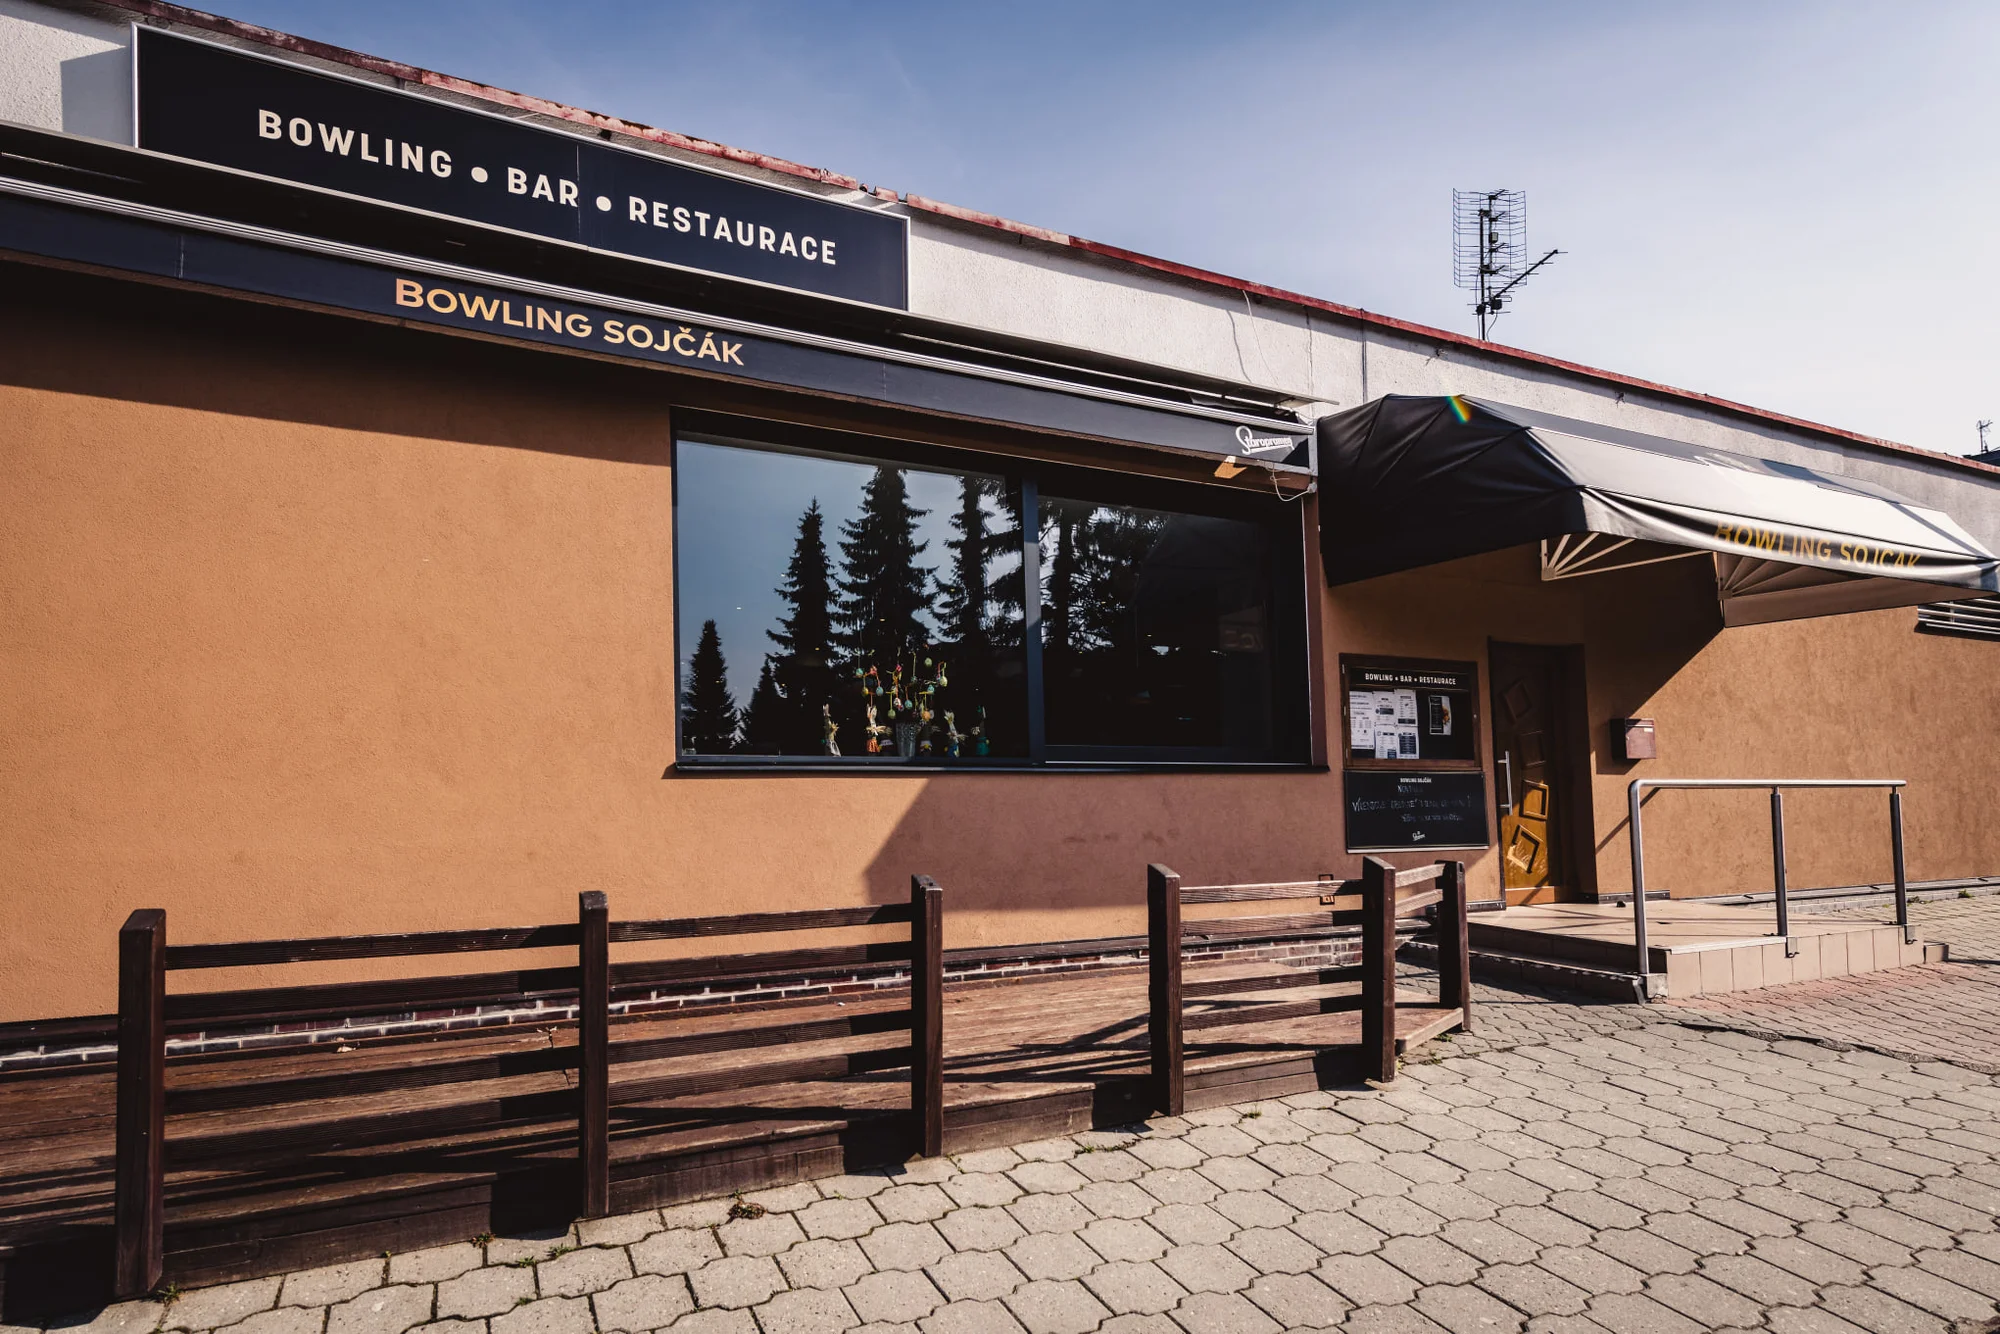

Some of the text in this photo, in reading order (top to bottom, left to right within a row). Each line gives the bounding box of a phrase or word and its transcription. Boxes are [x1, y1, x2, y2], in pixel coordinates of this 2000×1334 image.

[258, 108, 837, 266] BOWLING BAR RESTAURACE
[394, 278, 744, 366] BOWLING SOJČÁK
[1714, 521, 1831, 562] BOWLING
[1365, 673, 1456, 685] BOWLING BAR RESTAURACE
